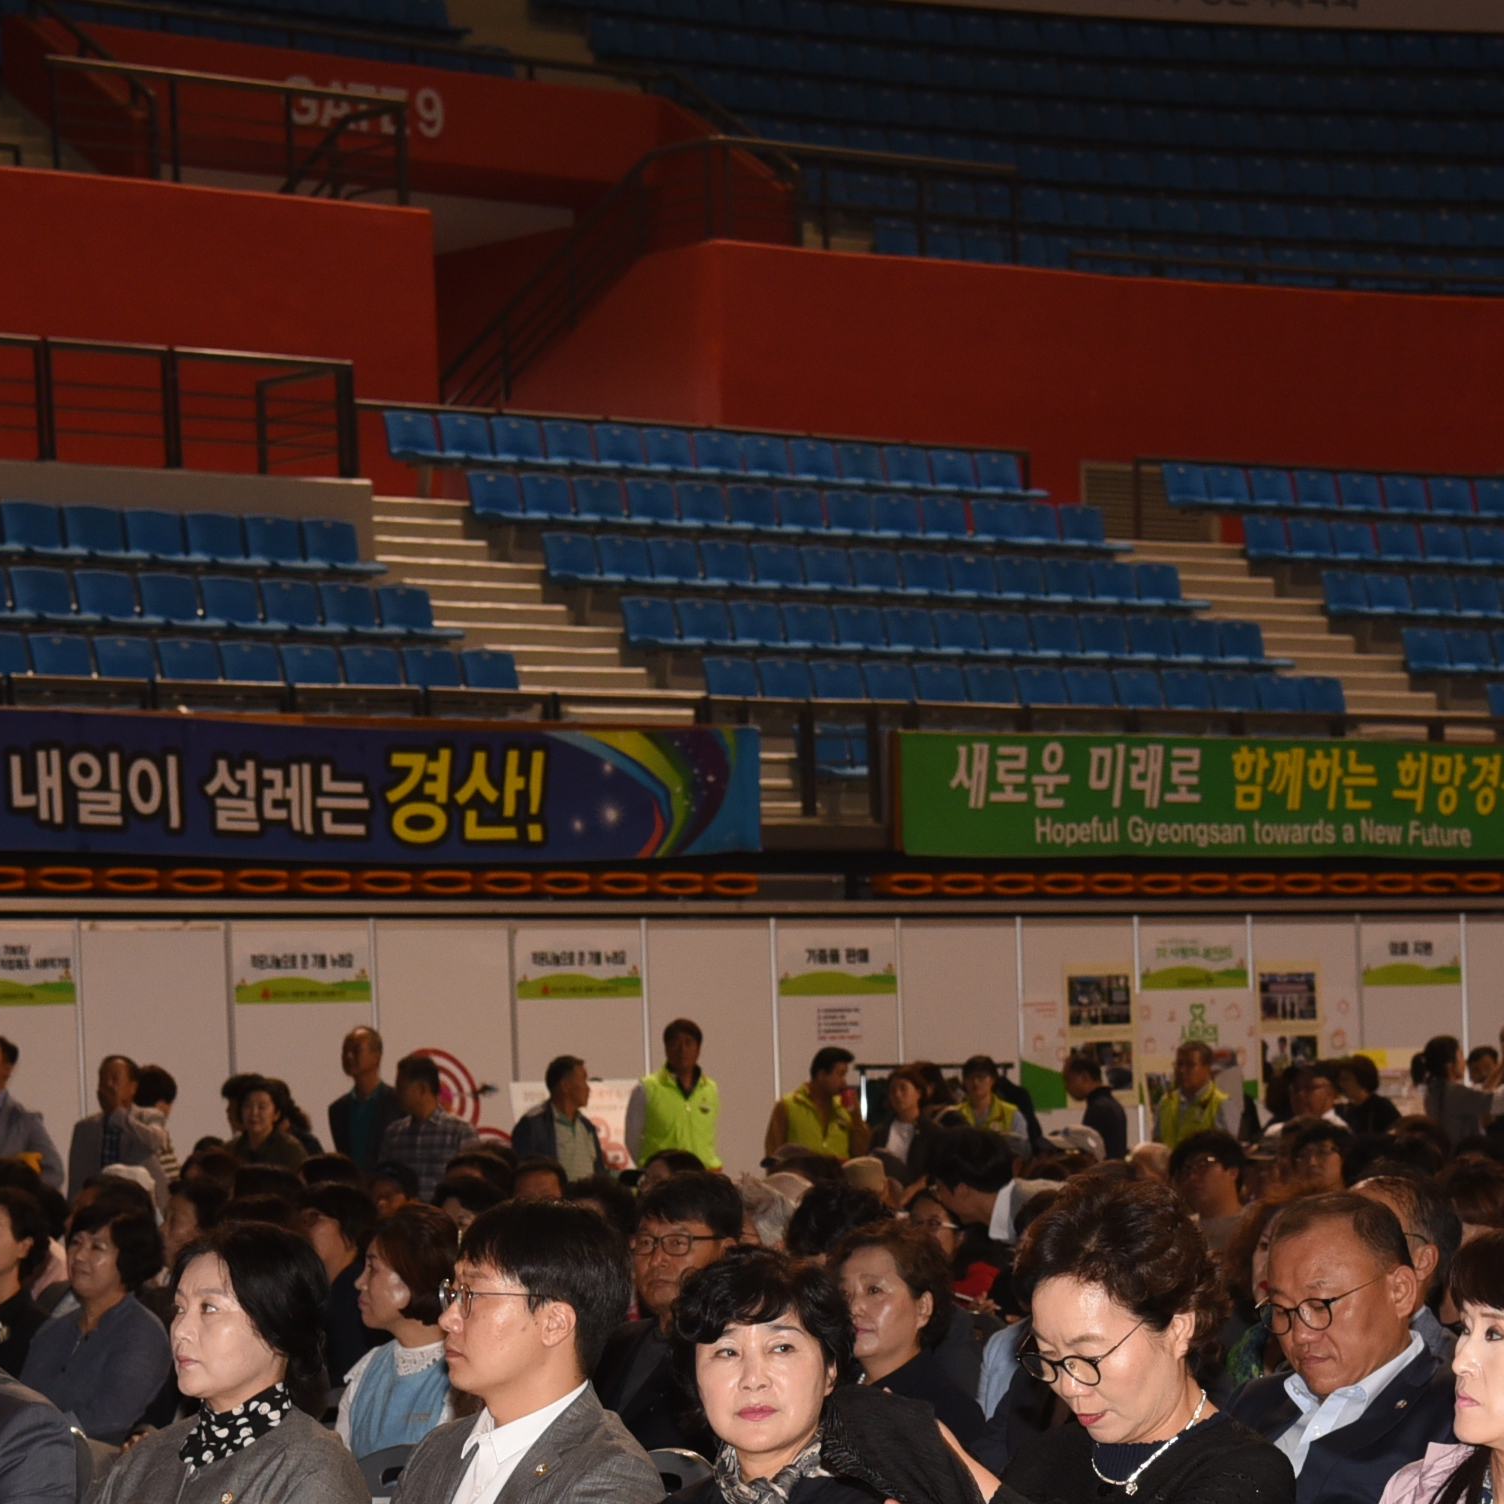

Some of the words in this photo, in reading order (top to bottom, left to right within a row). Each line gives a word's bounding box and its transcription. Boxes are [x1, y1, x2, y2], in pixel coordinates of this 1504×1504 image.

[415, 88, 445, 138] 9
[9, 748, 183, 831] 내일이
[204, 756, 370, 837] 설레는
[384, 748, 547, 844] 경산!
[950, 742, 1071, 810] 새로운
[1088, 742, 1202, 809] 미래로
[1230, 745, 1379, 812] 함께하는
[1034, 815, 1119, 846] Hopeful
[1126, 816, 1246, 847] Gyeongsan
[1252, 819, 1336, 846] towards
[1342, 826, 1356, 846] a
[1360, 818, 1403, 847] New
[1407, 820, 1472, 849] Future
